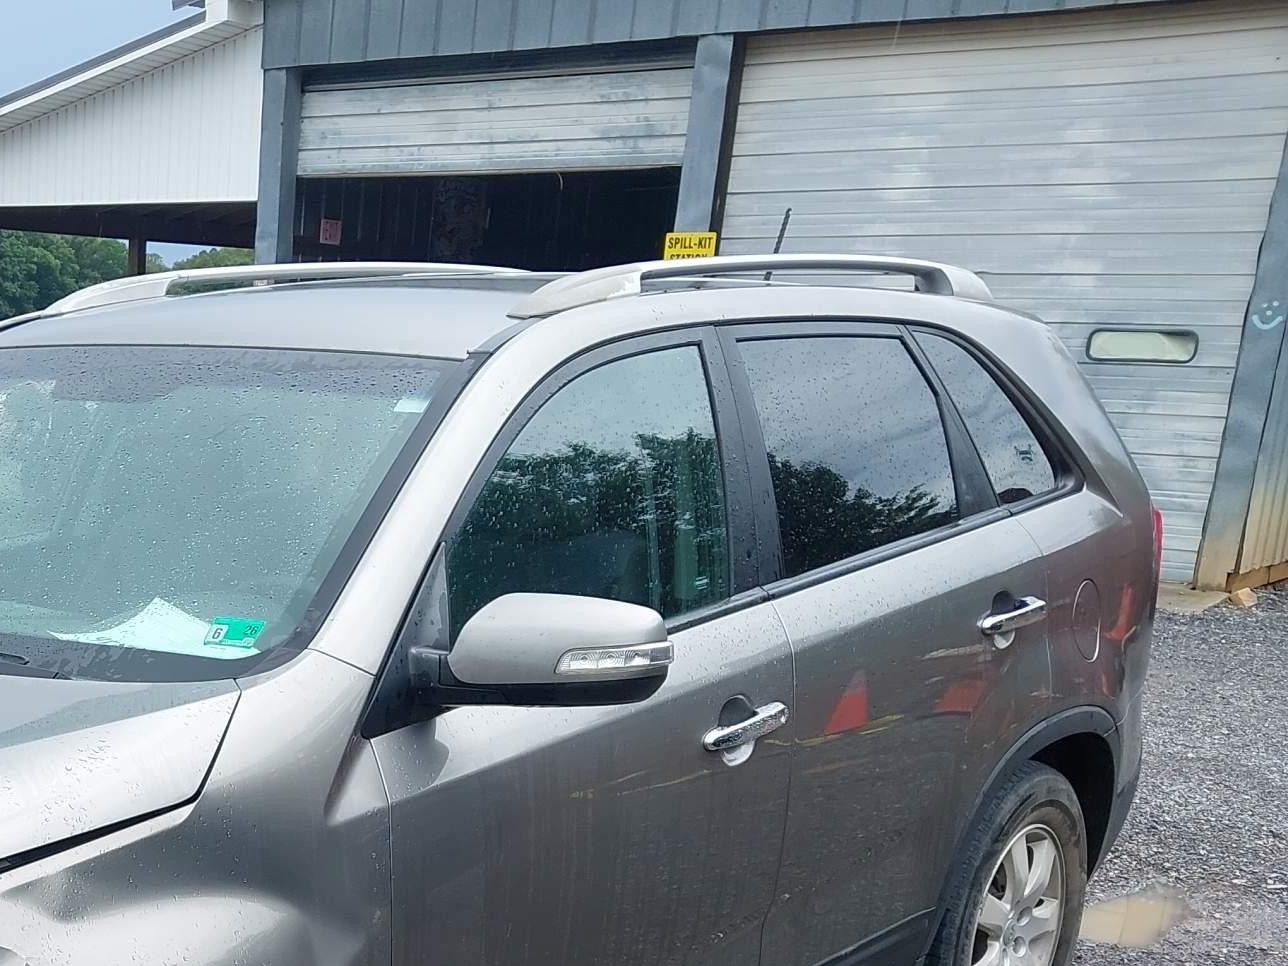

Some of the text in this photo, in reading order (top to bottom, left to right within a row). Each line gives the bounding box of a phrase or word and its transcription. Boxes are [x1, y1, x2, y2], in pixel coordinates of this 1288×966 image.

[668, 237, 713, 249] SPILL-KIT
[212, 627, 223, 640] 6
[243, 625, 259, 636] 26
